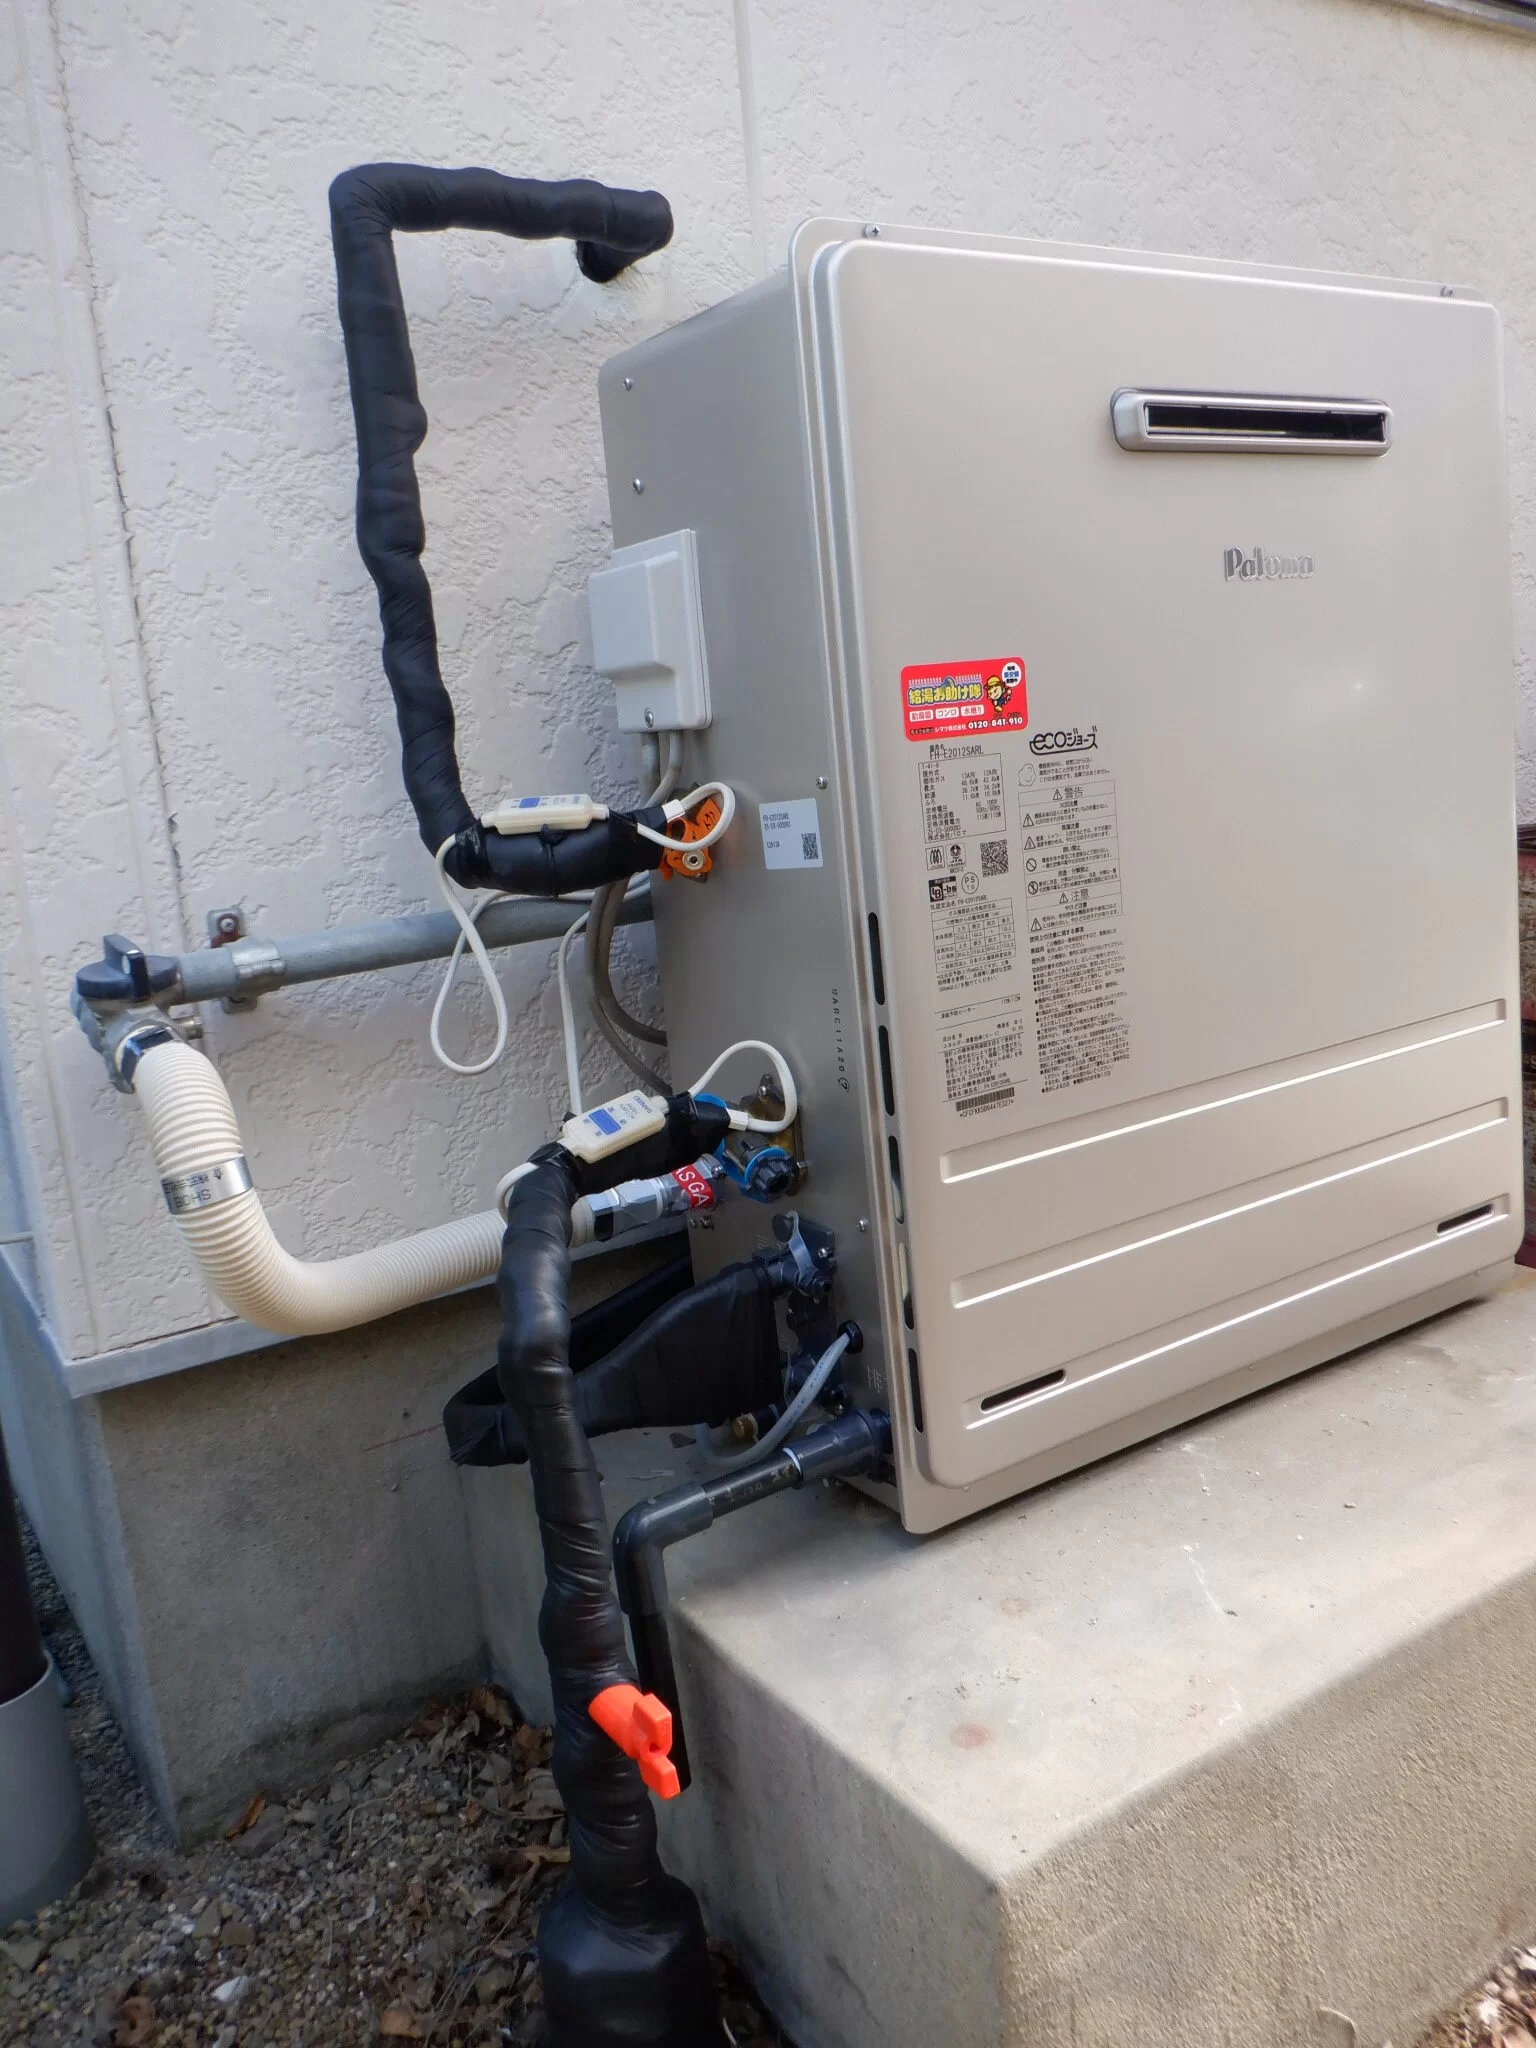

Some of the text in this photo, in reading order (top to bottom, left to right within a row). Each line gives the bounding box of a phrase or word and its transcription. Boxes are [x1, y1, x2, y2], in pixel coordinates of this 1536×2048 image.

[1224, 547, 1315, 581] Paloma
[908, 683, 982, 704] 給湯お助け隊
[968, 717, 1023, 729] 0120-841-910
[1065, 787, 1083, 799] 警告
[1071, 889, 1089, 900] 注意
